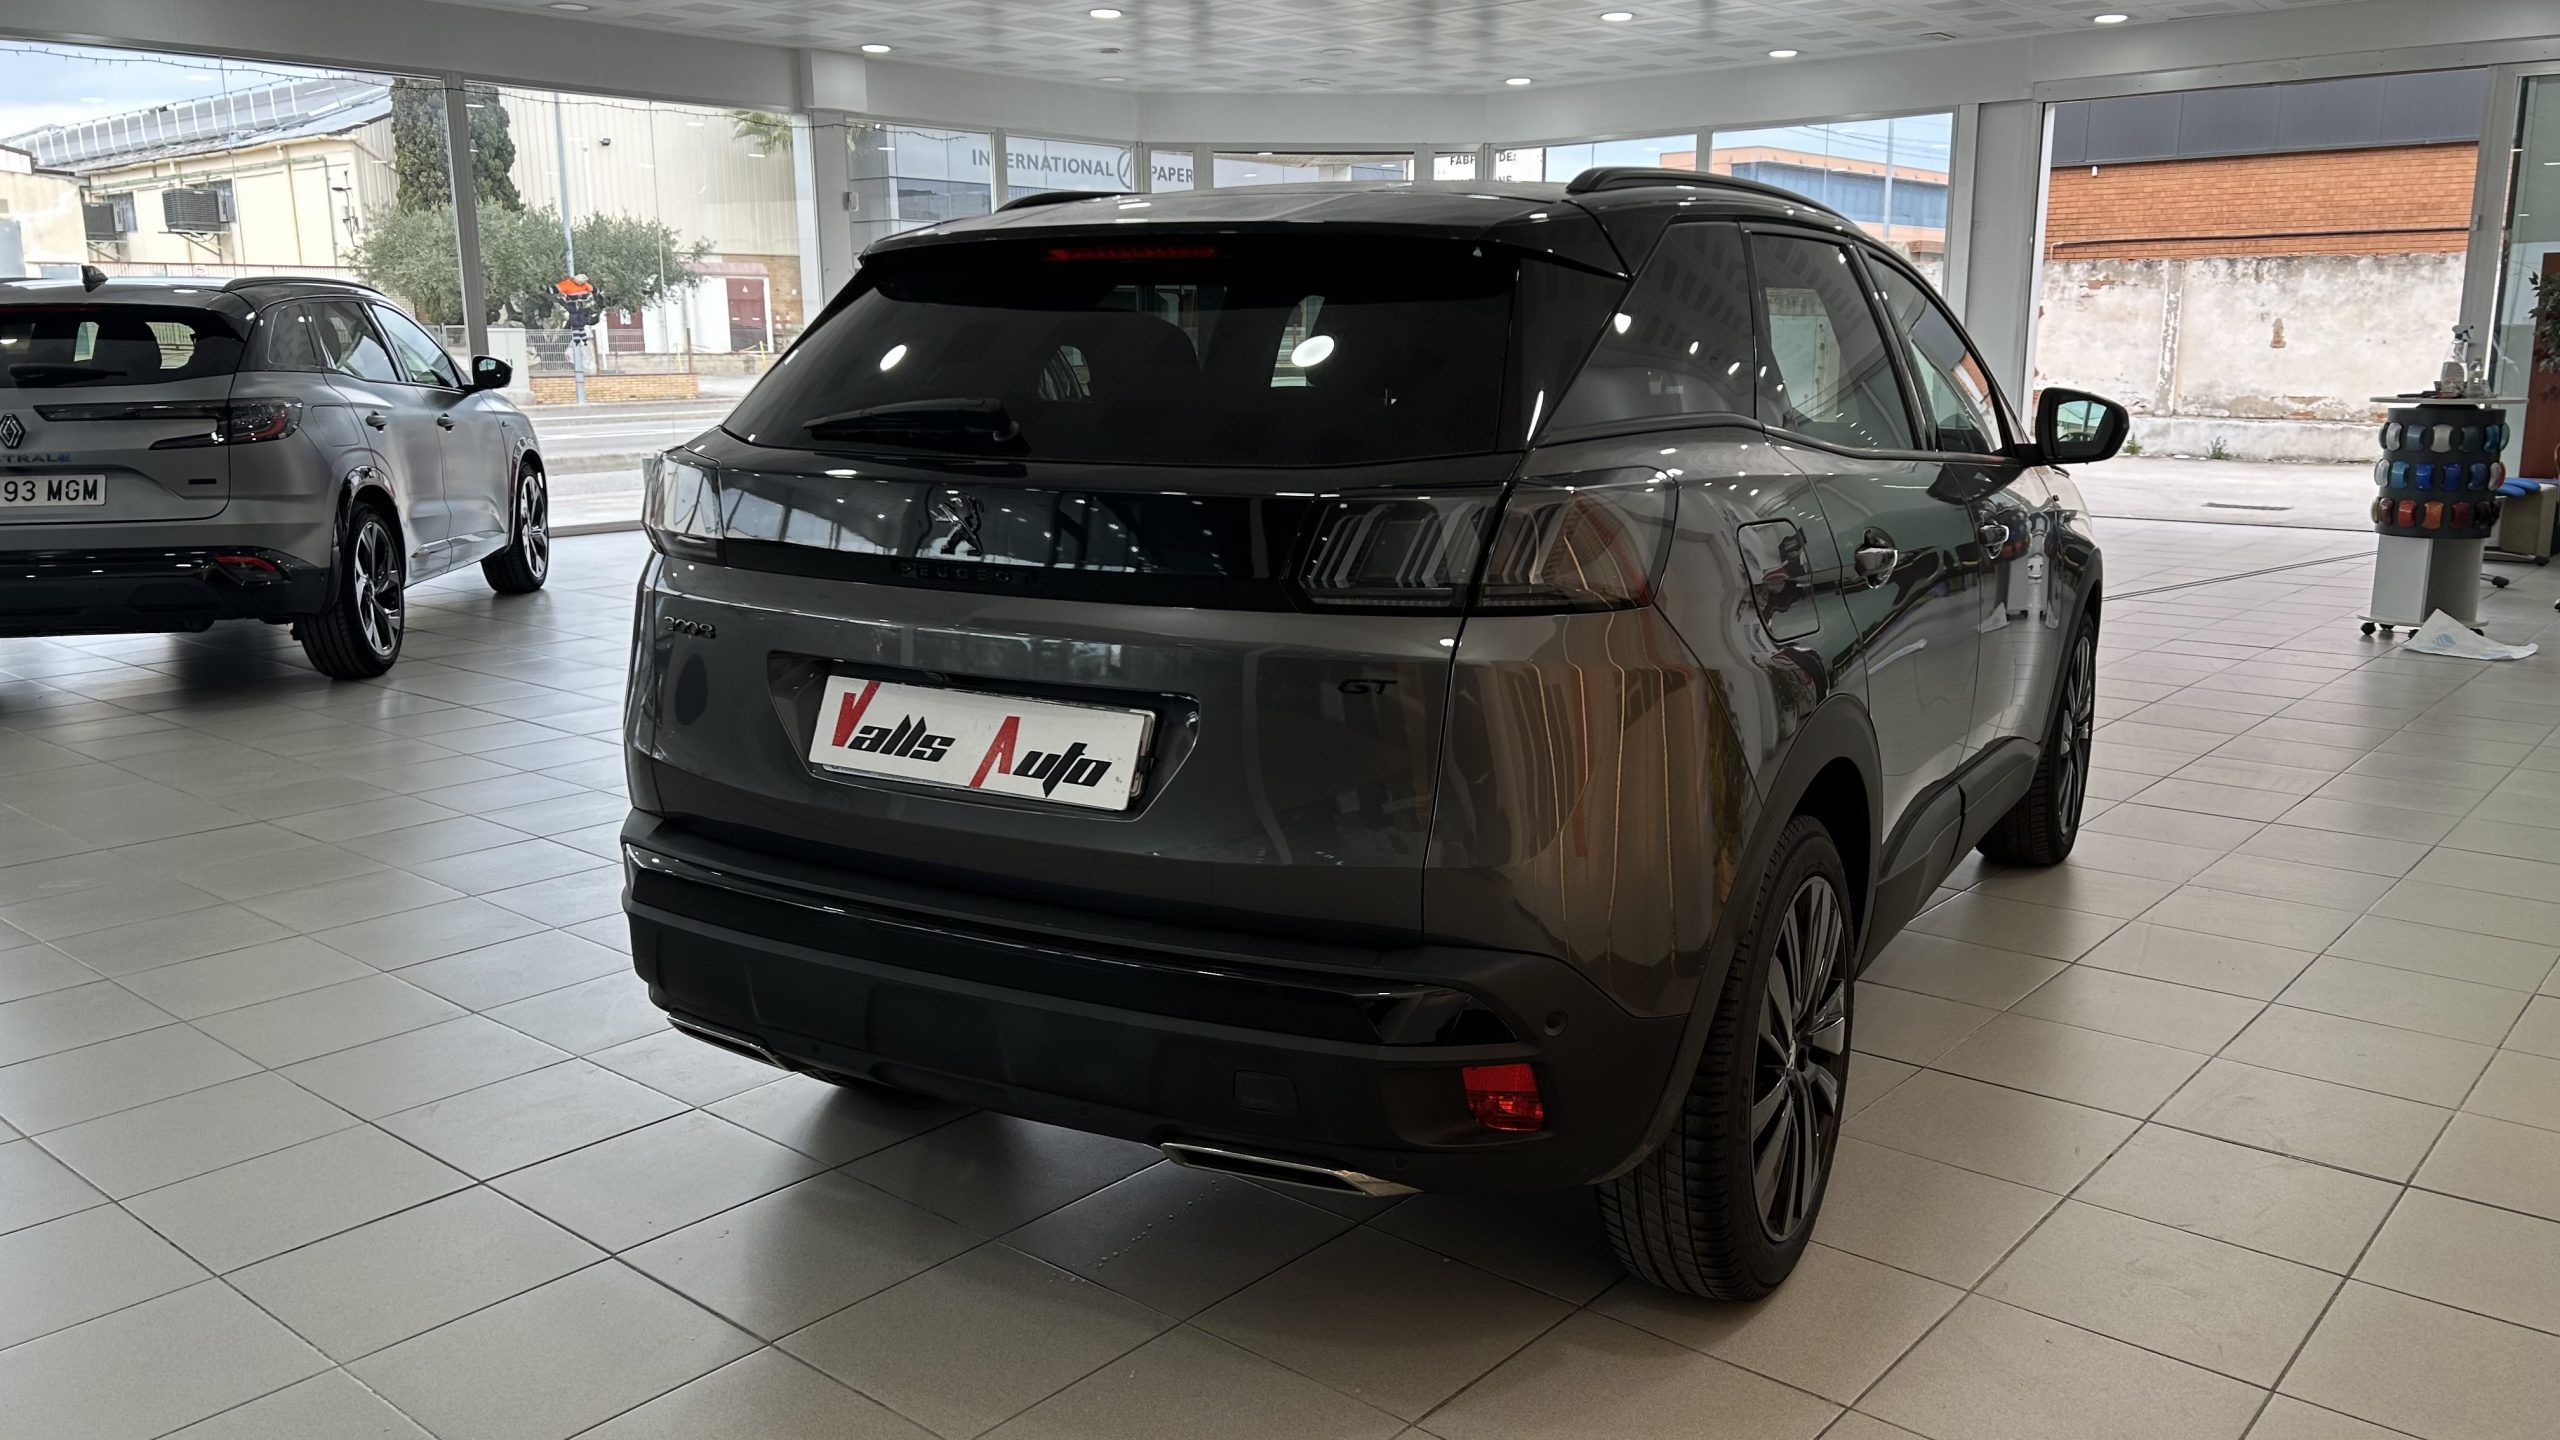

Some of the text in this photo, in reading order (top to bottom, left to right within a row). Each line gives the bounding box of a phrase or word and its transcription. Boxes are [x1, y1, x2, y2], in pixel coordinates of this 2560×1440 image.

[972, 149, 1114, 176] INERNATIONAL
[0, 453, 72, 463] TRALE
[0, 479, 98, 502] 93 MGM
[1336, 679, 1398, 695] GT
[831, 681, 1112, 798] Valls Auto
